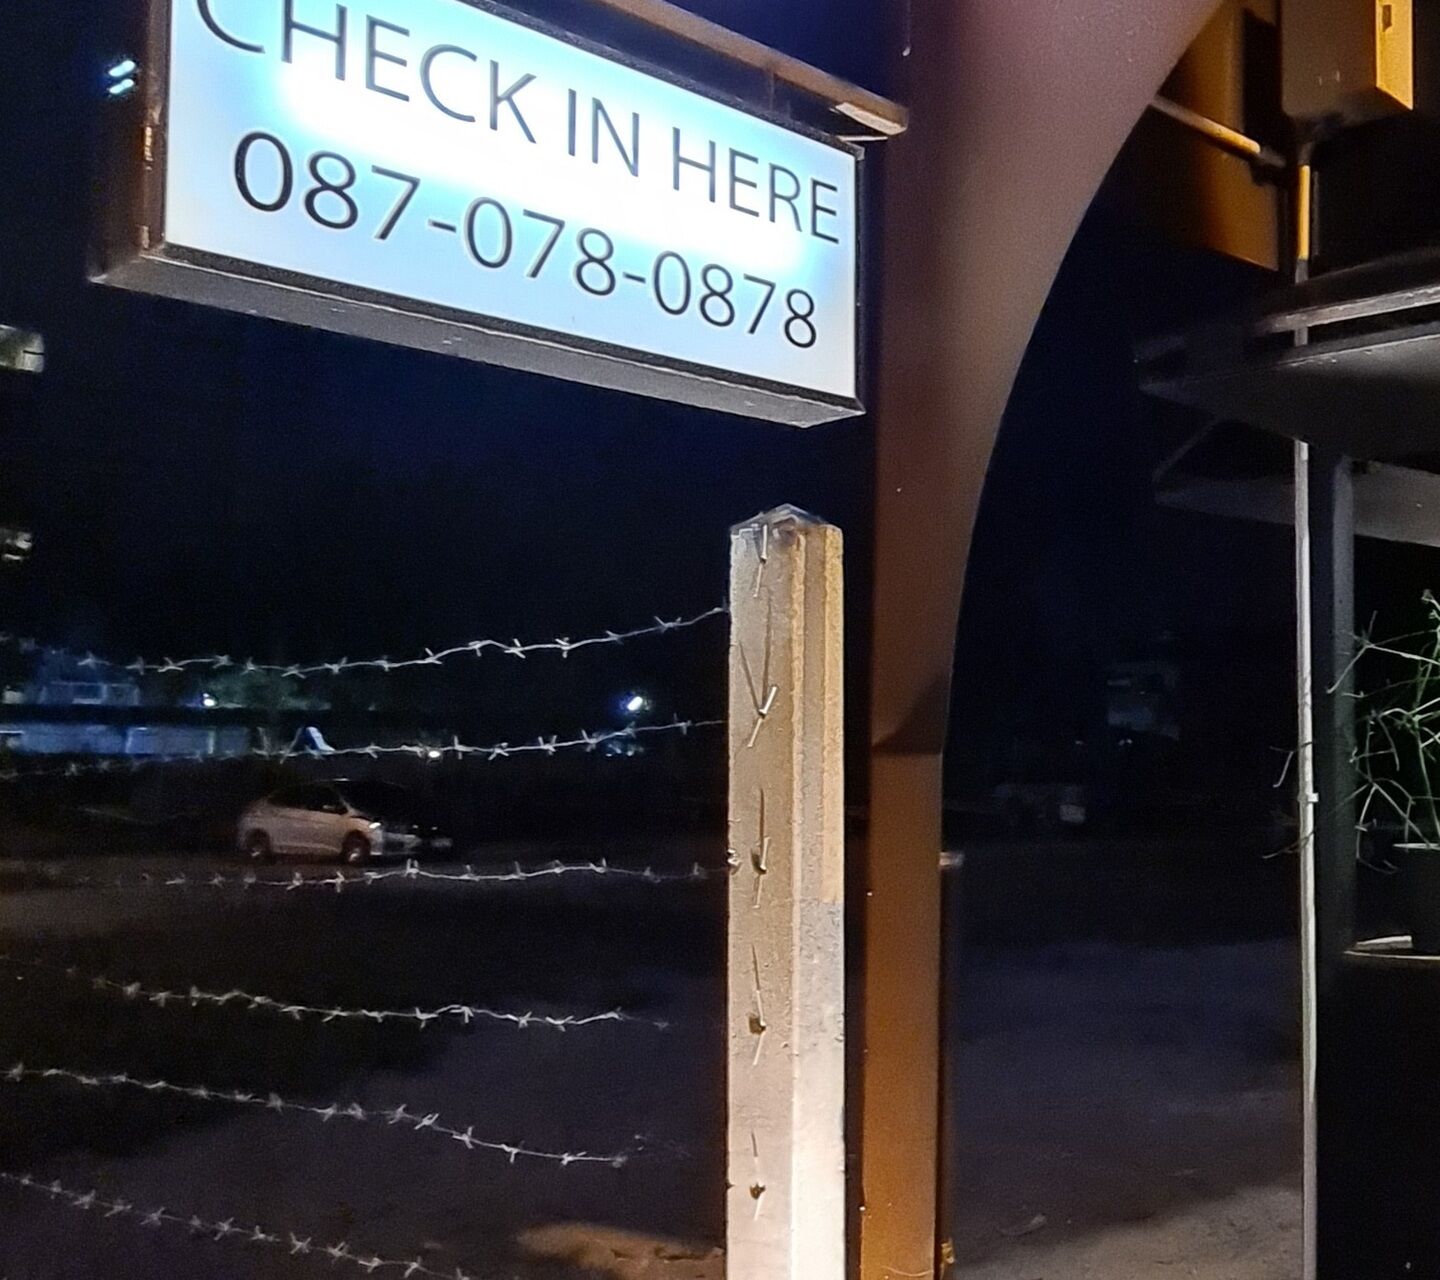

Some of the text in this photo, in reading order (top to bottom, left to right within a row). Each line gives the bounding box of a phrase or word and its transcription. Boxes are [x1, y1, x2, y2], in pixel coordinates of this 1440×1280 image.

[233, 130, 818, 350] 087-078-0878
[566, 87, 641, 178] IN
[672, 126, 840, 245] HERE
